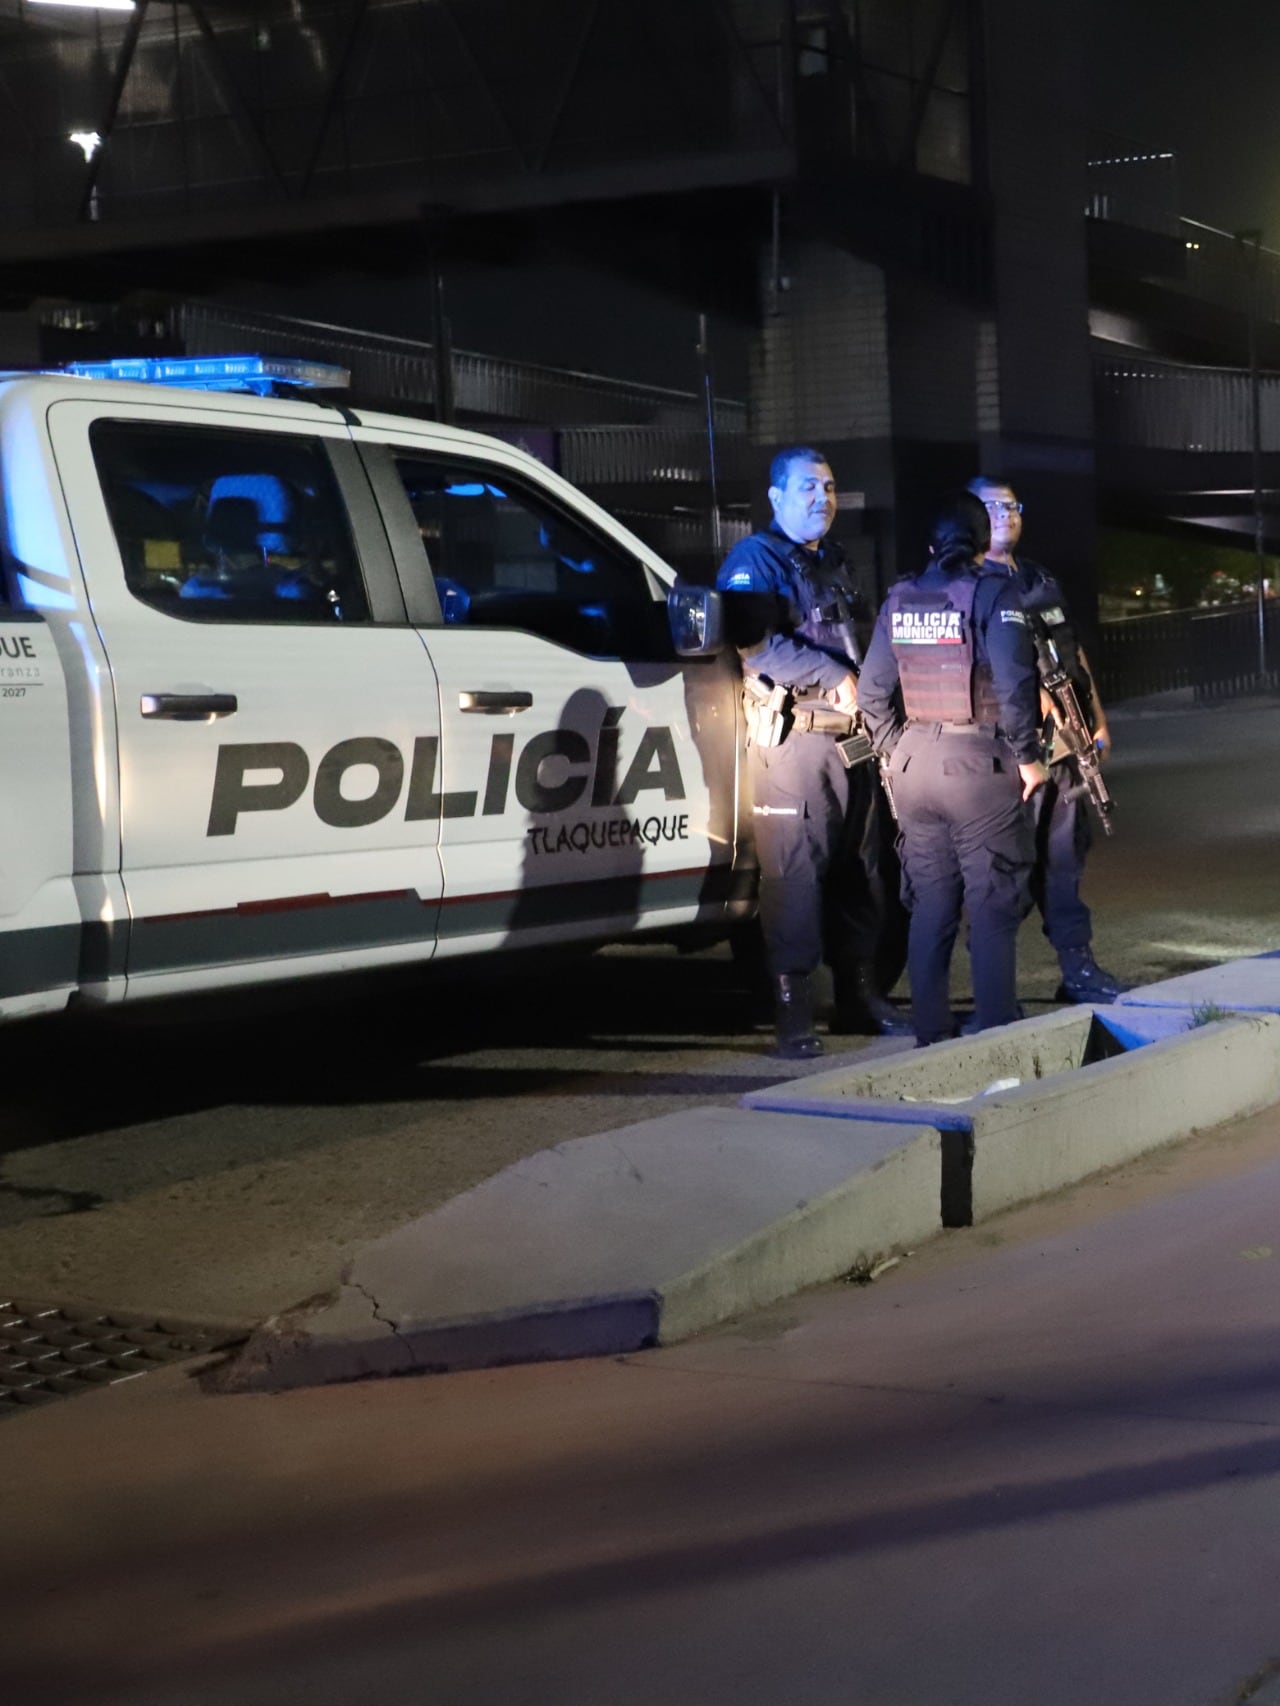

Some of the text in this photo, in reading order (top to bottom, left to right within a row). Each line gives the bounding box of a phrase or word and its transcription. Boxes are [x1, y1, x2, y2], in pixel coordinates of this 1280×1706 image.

[892, 626, 961, 639] MUNICIPAL
[0, 636, 37, 658] UE
[2, 687, 26, 698] 2027
[206, 706, 686, 837] POLICÍA
[527, 814, 689, 855] TLAQUEPAQUE
